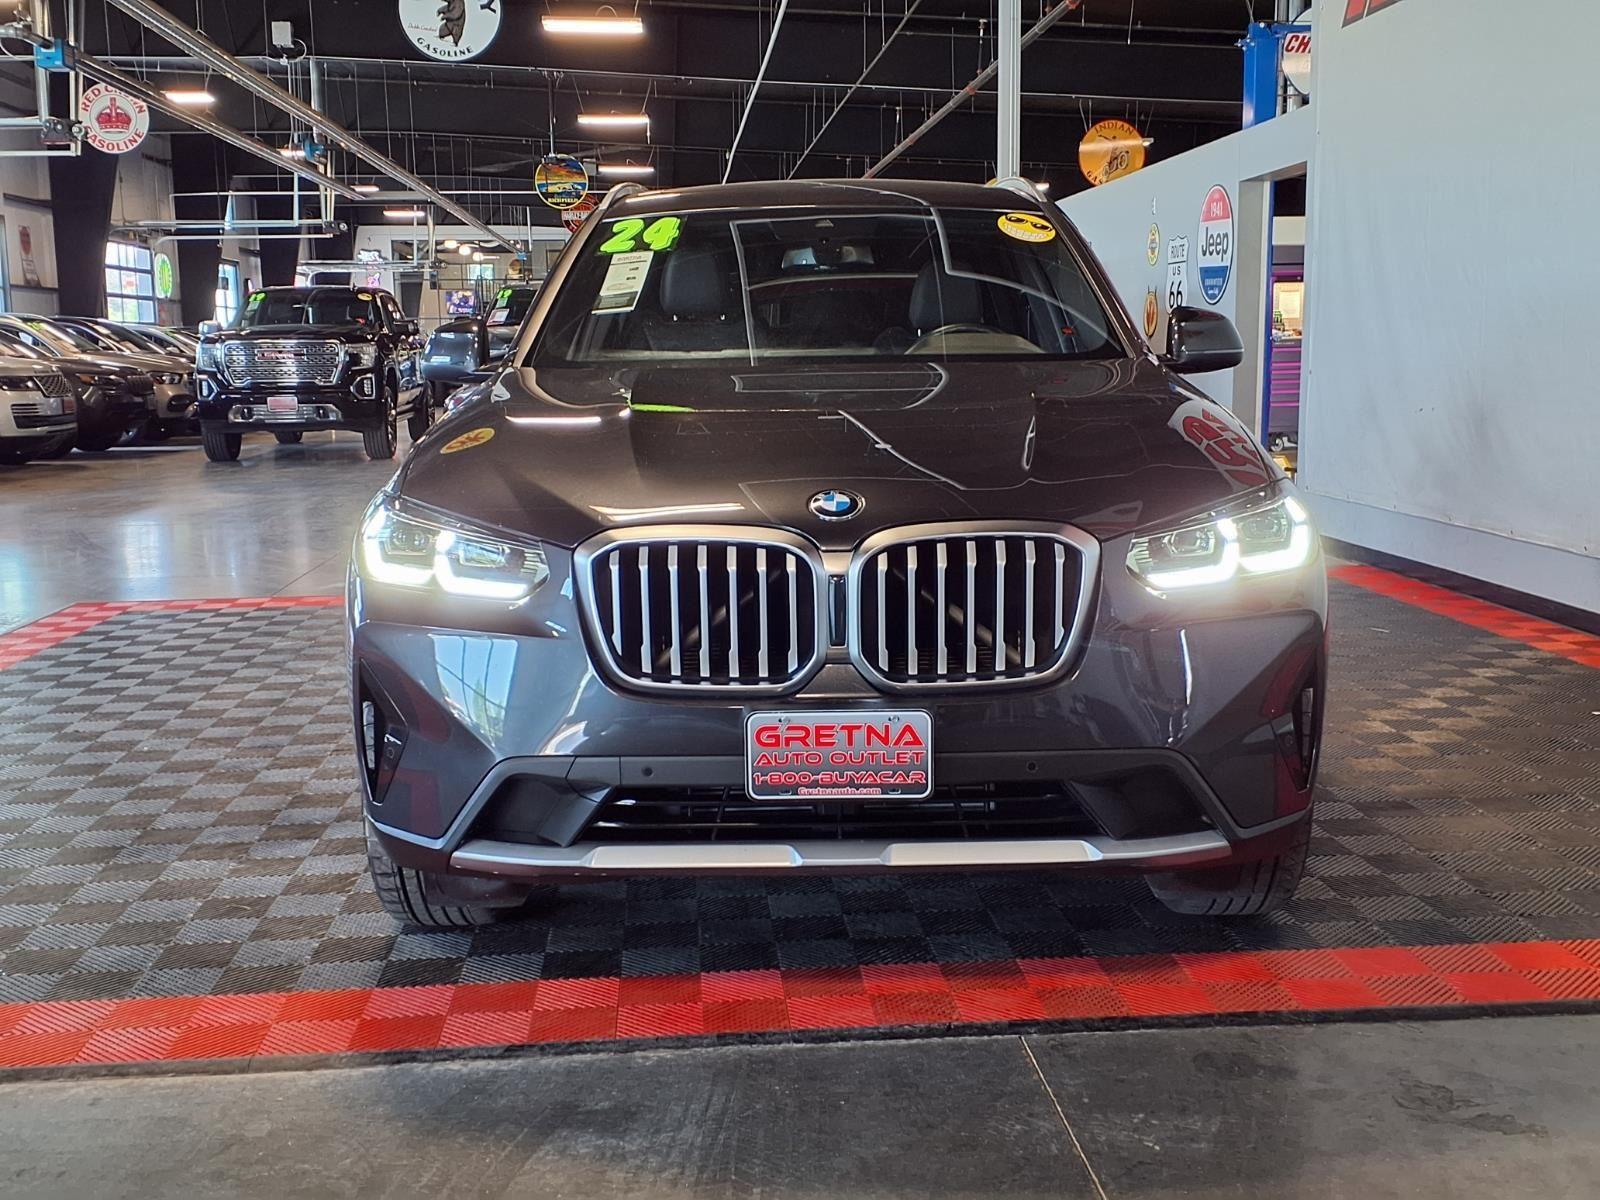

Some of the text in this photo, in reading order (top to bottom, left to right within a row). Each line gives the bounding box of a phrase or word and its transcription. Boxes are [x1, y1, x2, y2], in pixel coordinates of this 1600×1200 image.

[416, 37, 474, 58] GASOLINE
[81, 87, 101, 112] RED
[1094, 121, 1134, 135] INDIAN
[1210, 201, 1223, 217] 1941
[600, 217, 680, 253] 24
[1170, 243, 1185, 259] ROUTE
[1201, 227, 1229, 262] Jeep
[1172, 265, 1181, 276] US
[1169, 280, 1183, 308] 66
[754, 722, 926, 749] GRETNA
[753, 750, 927, 767] AUTO OUTLET
[753, 770, 927, 785] 1-800-BUYACAR
[797, 786, 882, 796] Gretnaauto.com
